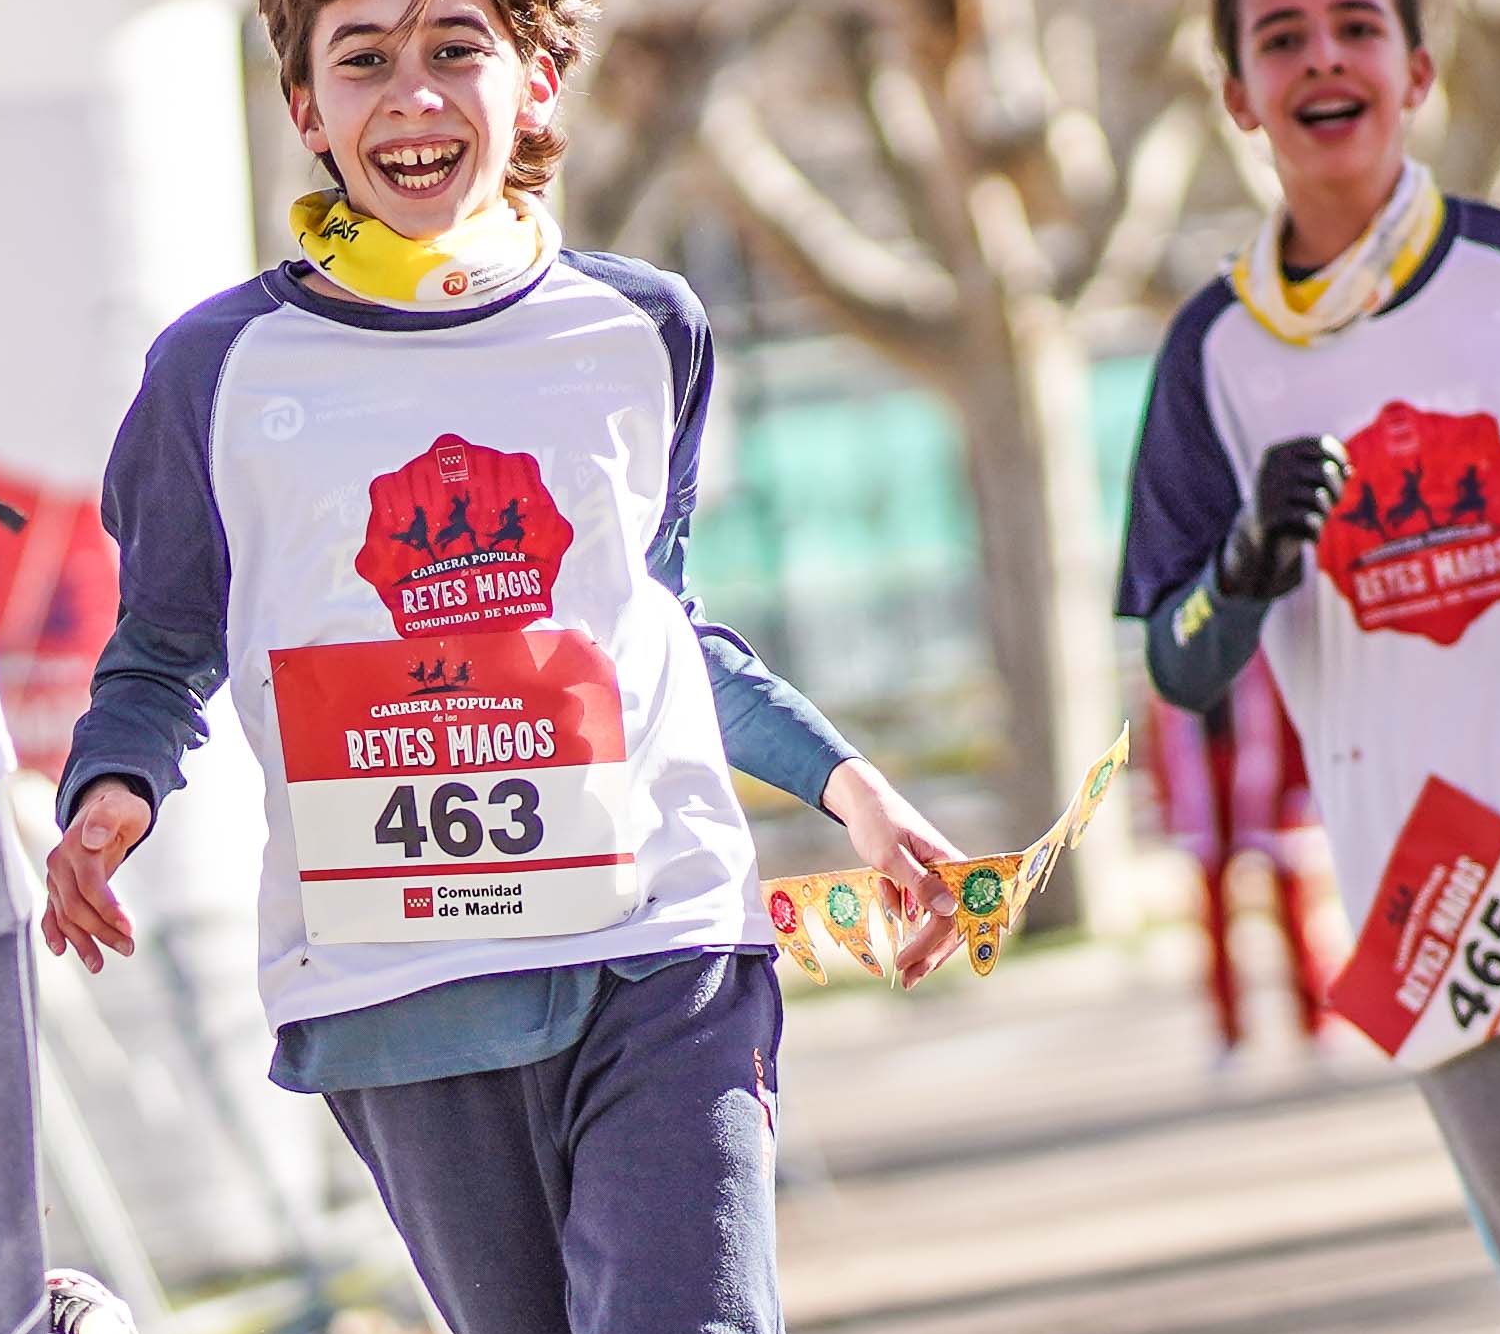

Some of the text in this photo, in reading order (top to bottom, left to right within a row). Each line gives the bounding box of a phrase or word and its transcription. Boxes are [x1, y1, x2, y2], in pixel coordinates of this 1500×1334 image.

[411, 552, 526, 579] CARRERA POPULAR
[402, 568, 541, 614] REYES MAGOS
[405, 611, 480, 631] COMUNIDAD
[485, 608, 501, 619] DE
[370, 697, 523, 718] CARRERA POPULAR
[432, 713, 443, 723] de
[345, 718, 555, 770] REYES MAGOS
[375, 778, 544, 858] 463
[437, 884, 522, 898] Comunidad
[438, 901, 523, 917] de Madrid
